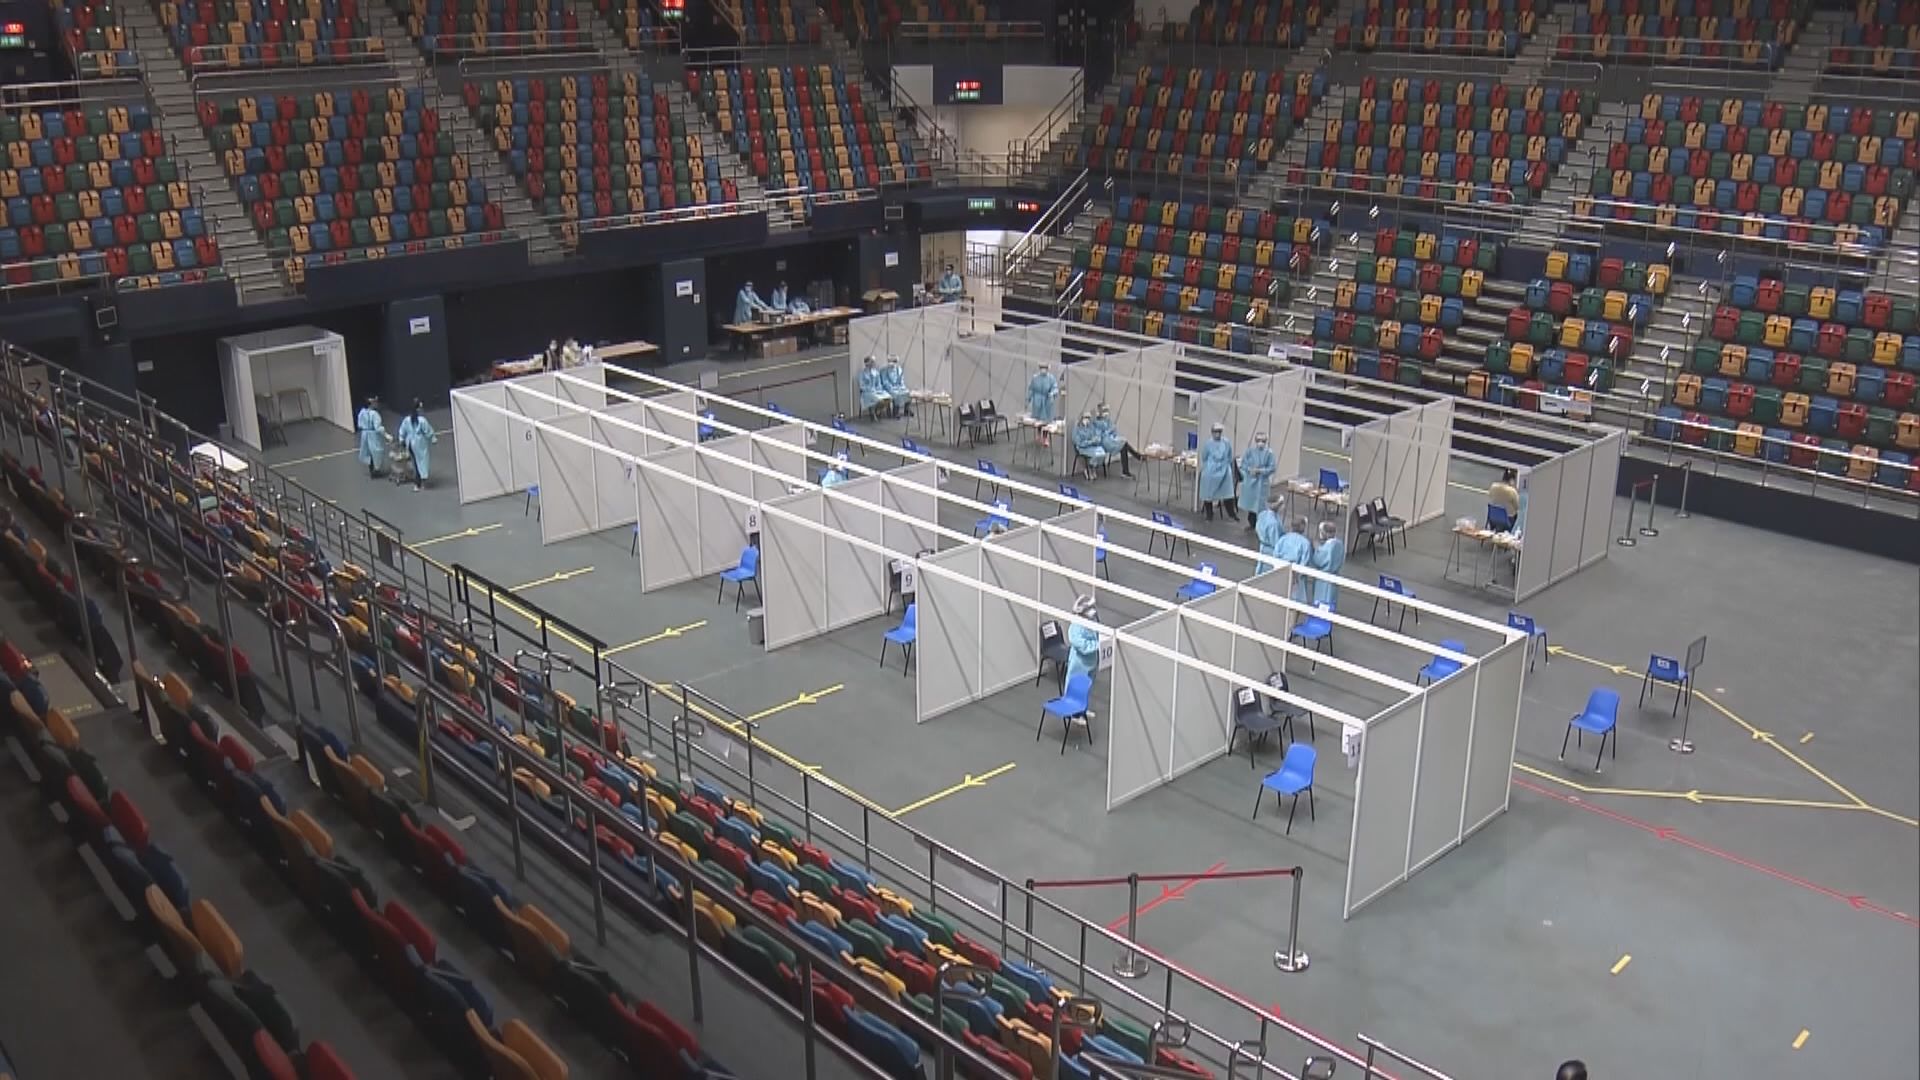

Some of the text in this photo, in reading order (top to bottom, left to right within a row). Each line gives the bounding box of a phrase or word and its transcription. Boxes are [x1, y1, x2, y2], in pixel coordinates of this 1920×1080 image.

[525, 430, 532, 441] 6
[626, 467, 632, 480] 7
[749, 515, 756, 527] 8
[905, 574, 912, 587] 9
[1102, 646, 1112, 660] 10
